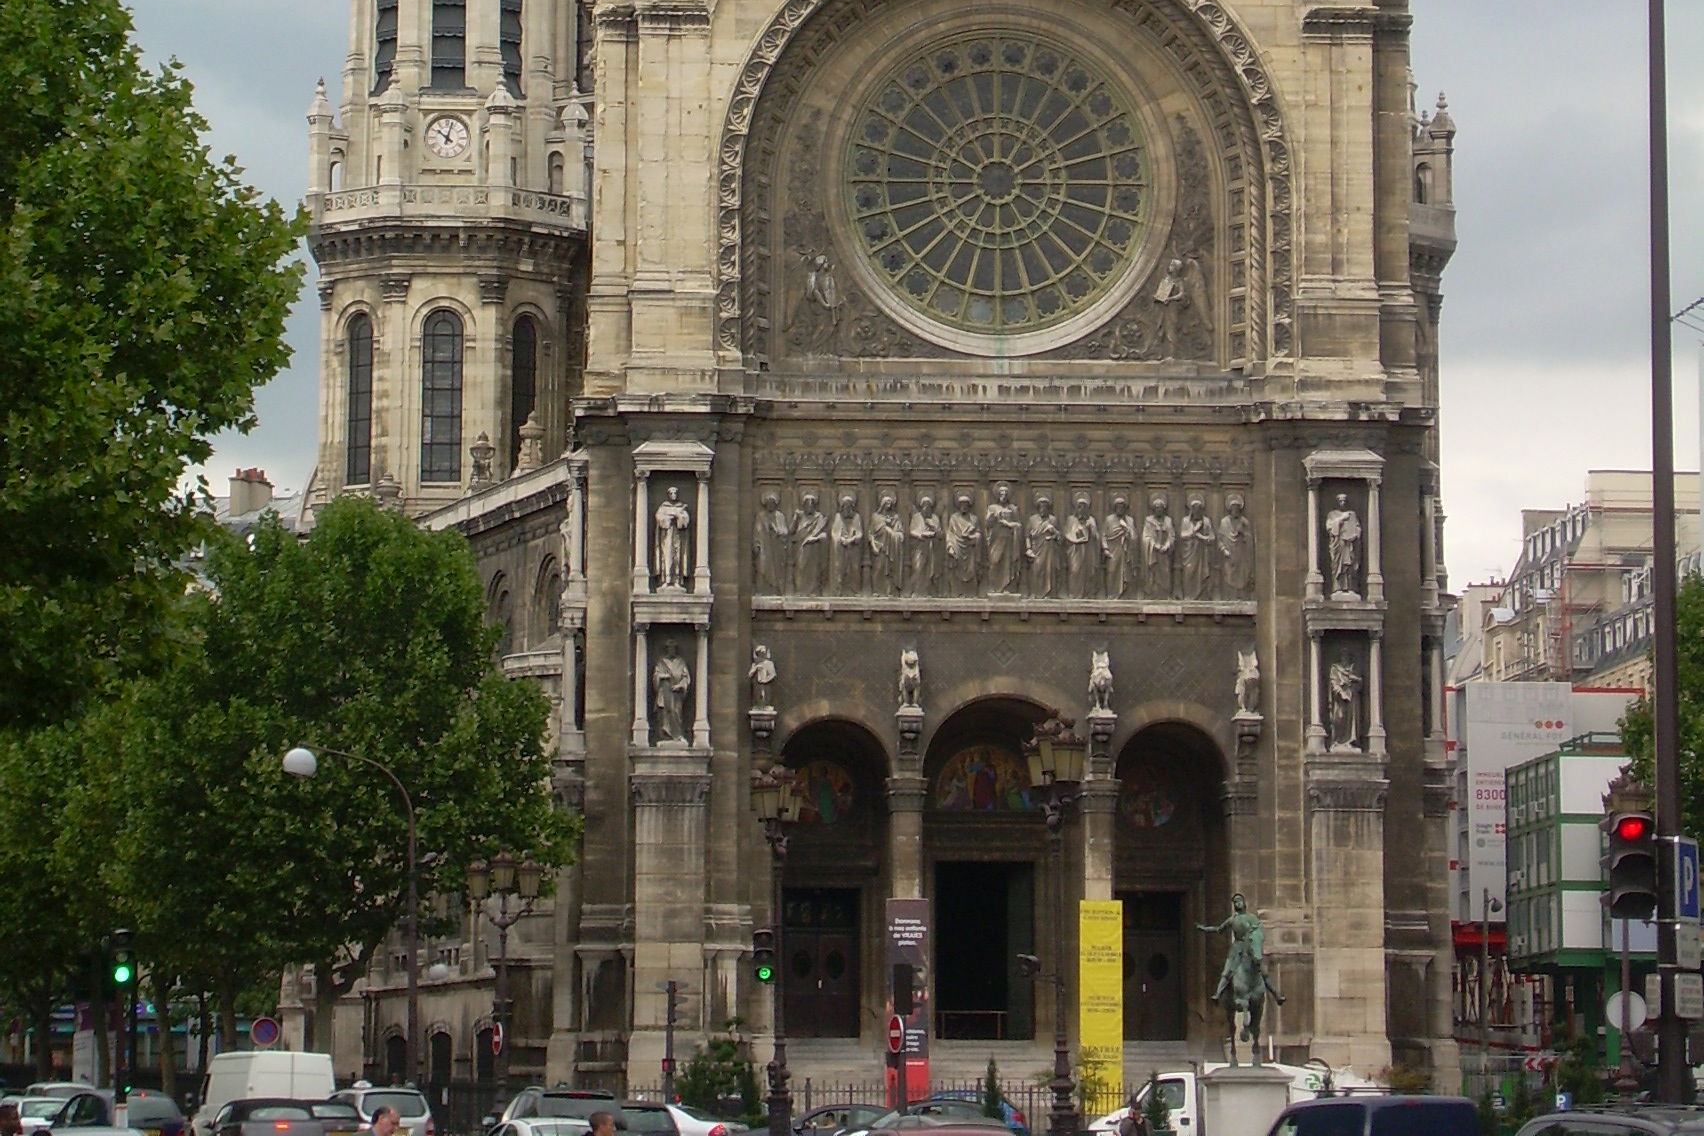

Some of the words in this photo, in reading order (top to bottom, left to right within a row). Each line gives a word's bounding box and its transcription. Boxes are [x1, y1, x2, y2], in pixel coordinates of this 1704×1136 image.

[1476, 789, 1506, 800] 8300
[1683, 855, 1694, 905] P
[1556, 1094, 1566, 1107] P
